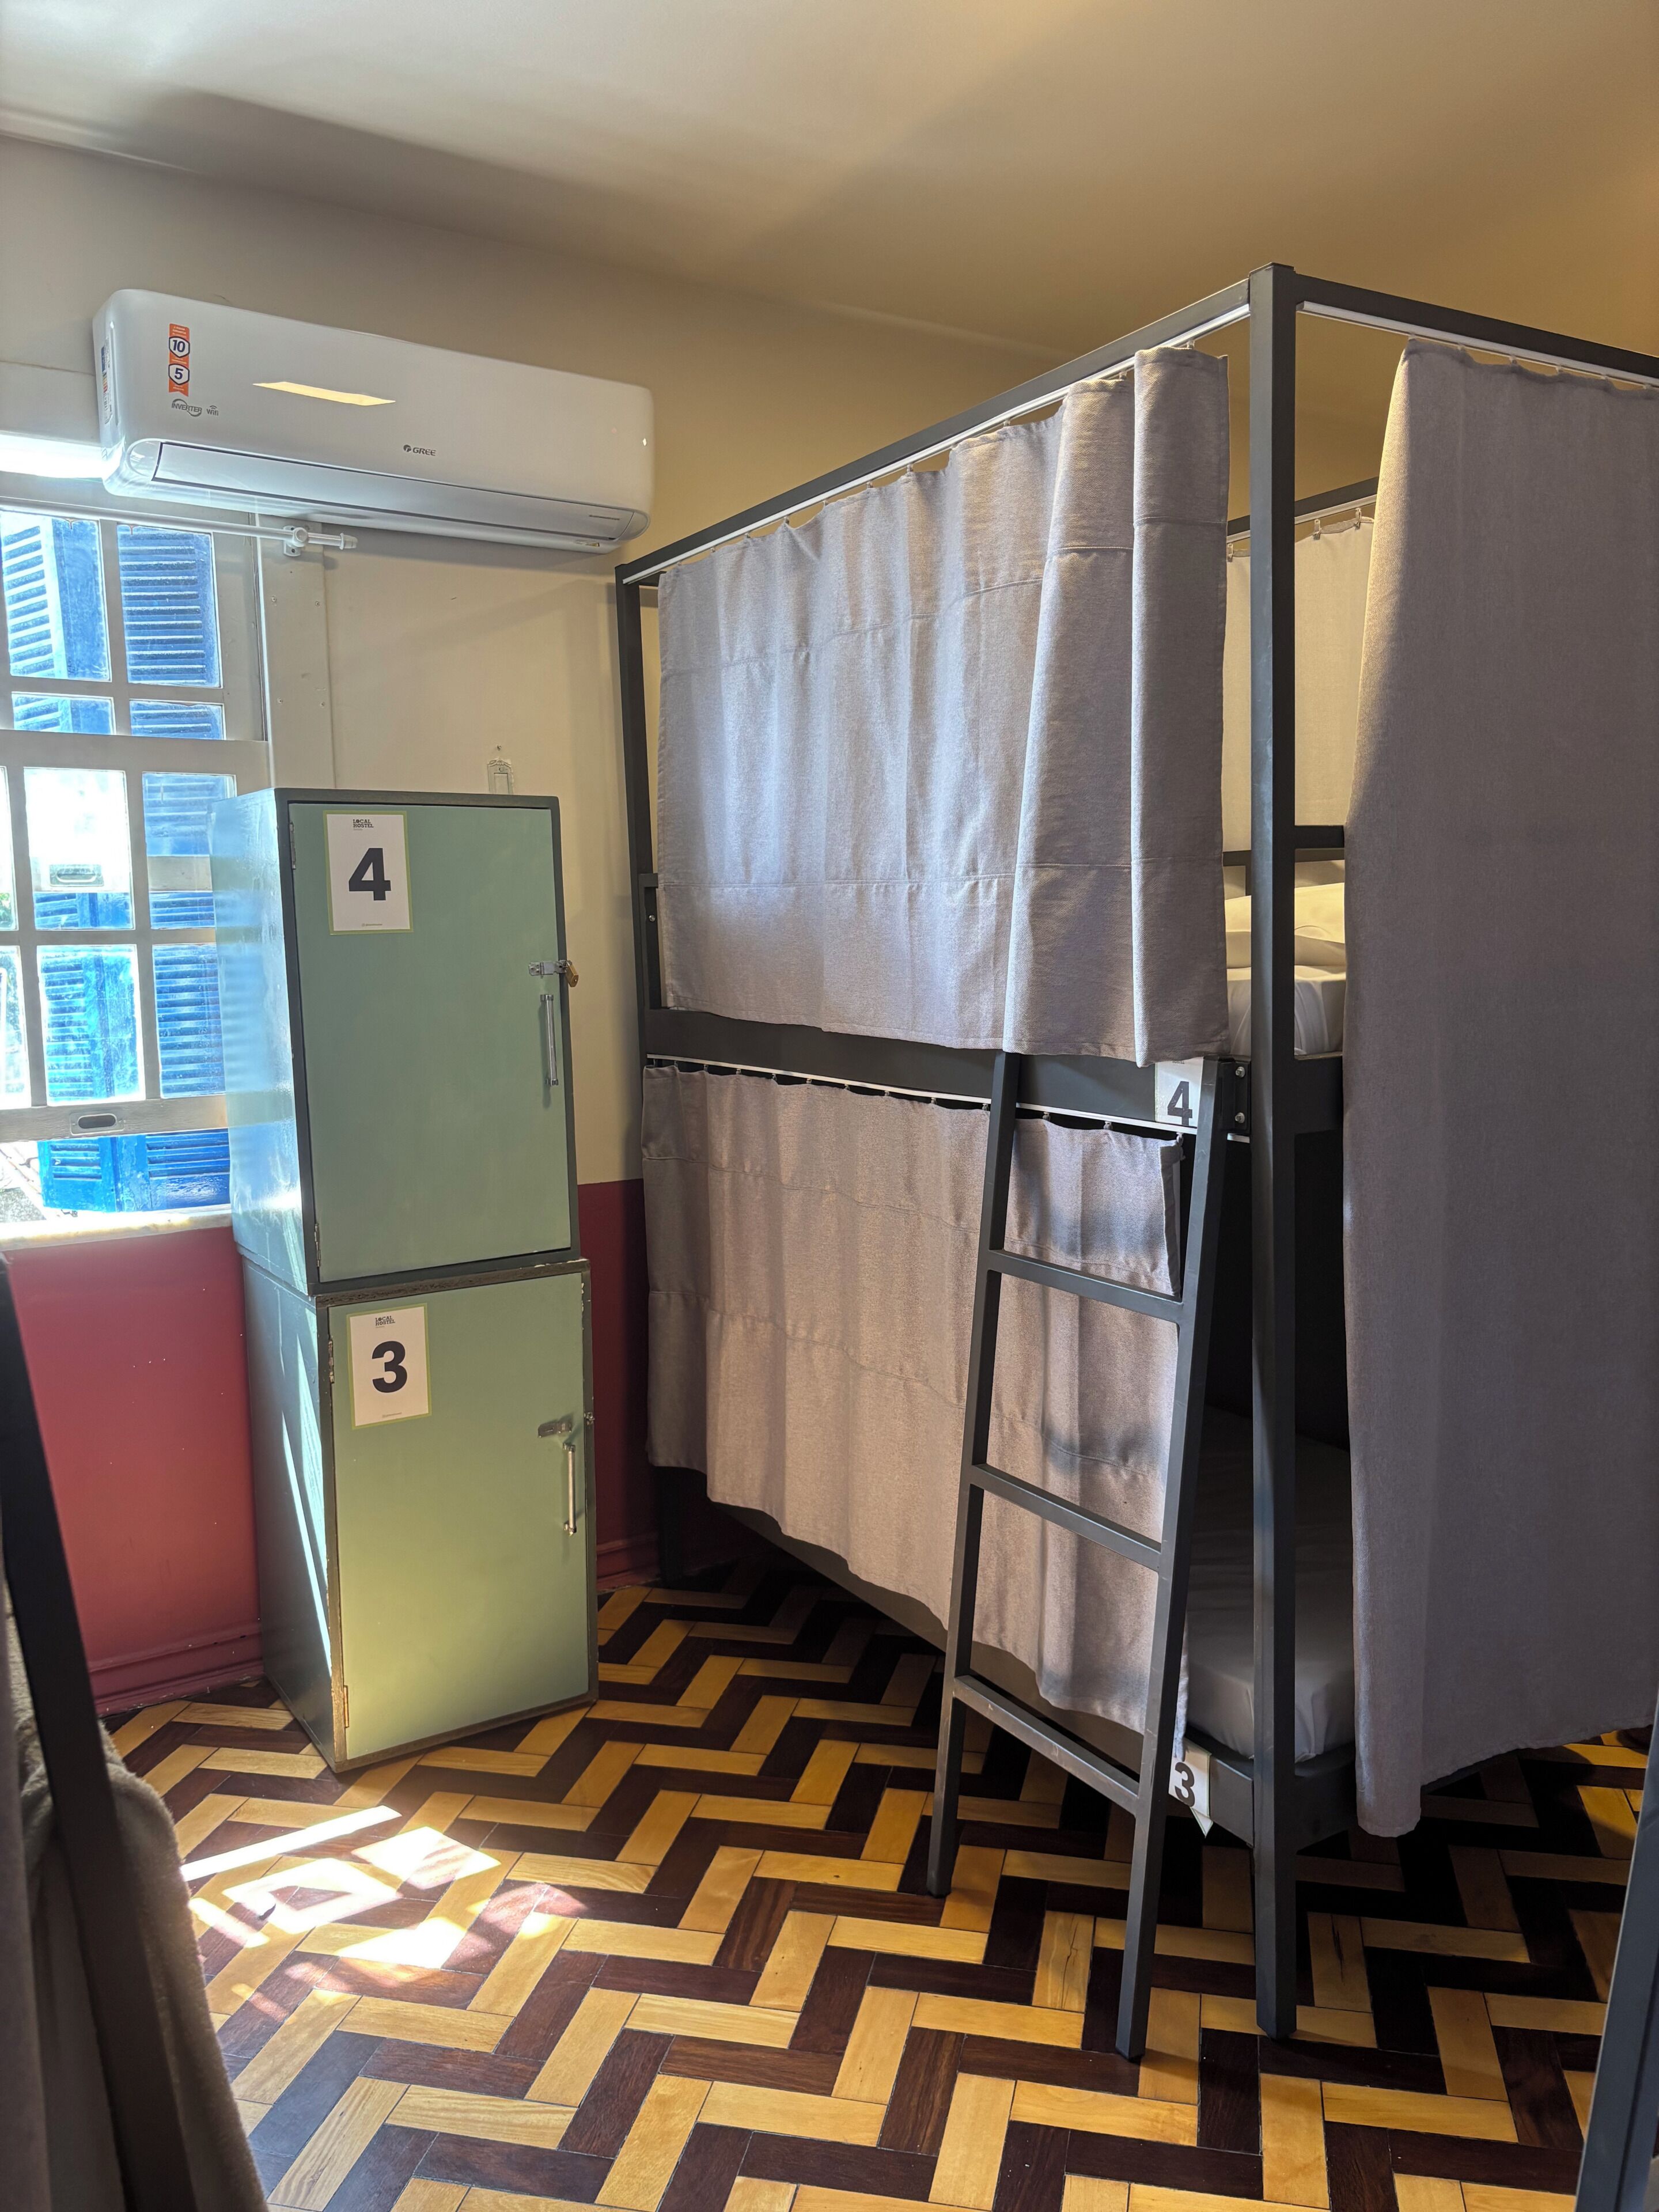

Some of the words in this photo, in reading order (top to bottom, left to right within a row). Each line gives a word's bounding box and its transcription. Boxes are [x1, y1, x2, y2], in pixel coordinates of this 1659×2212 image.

[173, 340, 185, 353] 10
[175, 368, 184, 380] 5
[172, 403, 202, 412] INVERTER
[412, 447, 436, 456] GREE
[349, 848, 391, 900] 4
[1167, 1081, 1192, 1126] 4
[372, 1340, 408, 1393] 3
[1175, 1762, 1195, 1808] 3
